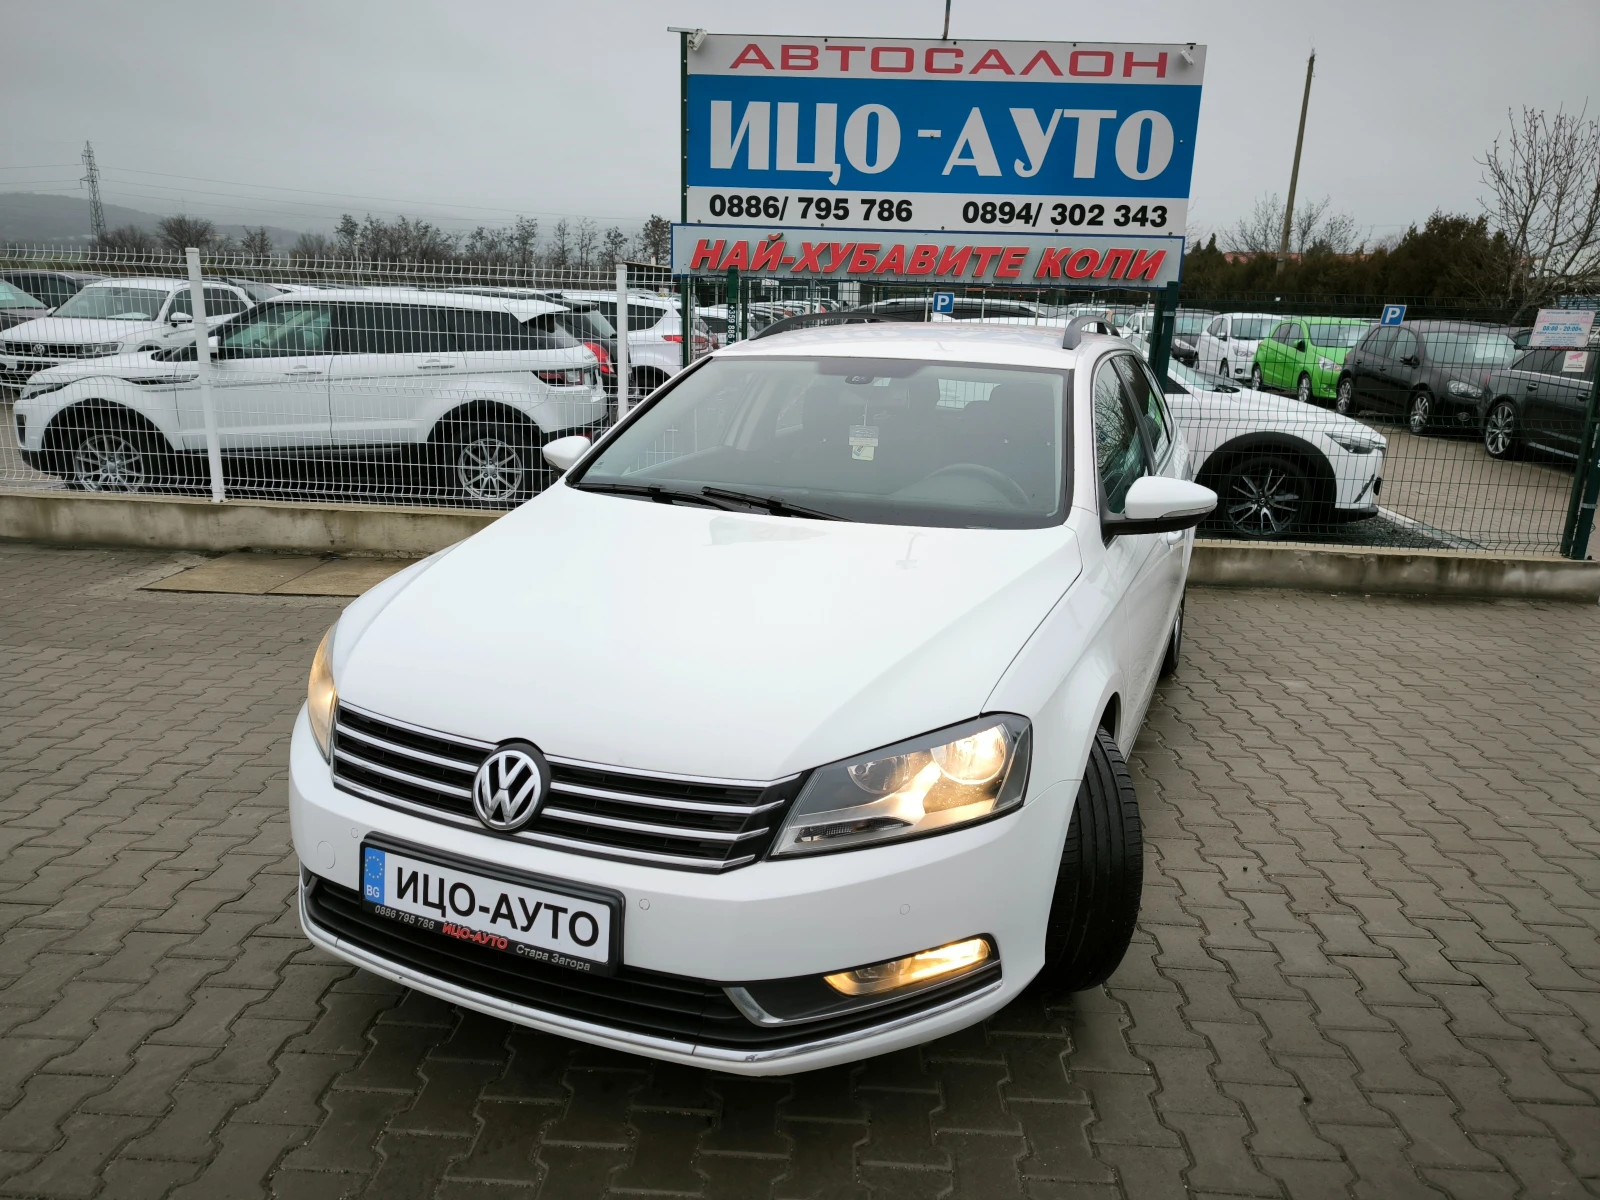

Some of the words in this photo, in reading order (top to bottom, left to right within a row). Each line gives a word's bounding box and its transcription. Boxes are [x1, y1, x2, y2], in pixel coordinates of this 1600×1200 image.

[728, 43, 1169, 79] АВТОСАЛОН
[709, 194, 789, 221] 0886/
[797, 197, 849, 220] 795
[860, 198, 913, 222] 786
[962, 201, 1043, 227] 0894/
[1050, 203, 1105, 226] 302
[1113, 205, 1168, 228] 343
[690, 232, 1030, 278] НАЙ-ХУБАВИТЕ
[1034, 247, 1168, 281] КОЛИ
[936, 295, 950, 311] P
[1385, 307, 1401, 324] P
[366, 884, 380, 898] BG
[374, 905, 397, 919] 0886
[398, 911, 416, 925] 795
[417, 917, 435, 930] 786
[396, 867, 599, 947] ИЦО-АУТО
[442, 920, 508, 950] ИЦО-АУТО
[516, 944, 549, 962] Стара
[551, 953, 591, 972] Загора
